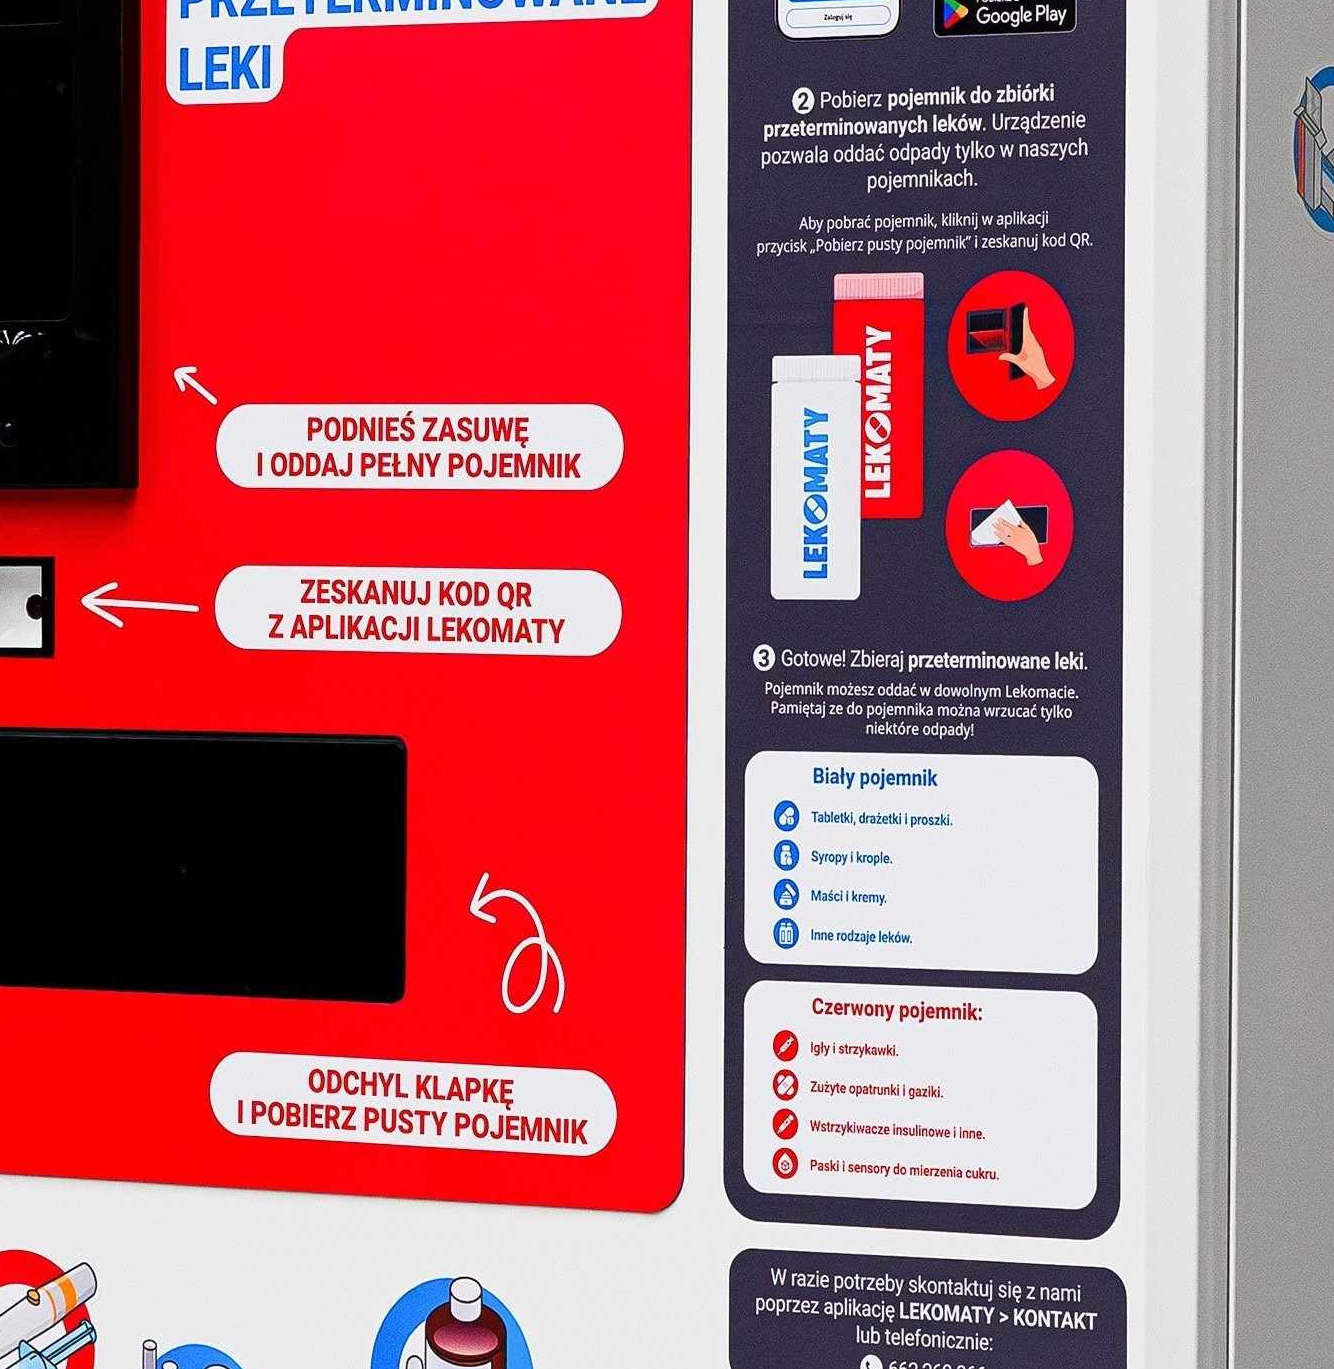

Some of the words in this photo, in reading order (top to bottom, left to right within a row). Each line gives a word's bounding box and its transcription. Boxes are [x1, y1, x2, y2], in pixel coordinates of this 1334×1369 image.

[976, 5, 1032, 27] Google
[1035, 4, 1067, 25] Play
[179, 44, 271, 91] LEKI
[820, 89, 882, 109] Pobierz
[887, 85, 966, 112] pojemnik
[970, 85, 992, 104] do
[996, 82, 1054, 103] zbiórki
[763, 114, 927, 142] przeterminowanych
[932, 113, 986, 132] leków.
[992, 110, 1086, 134] Urządzenie
[761, 145, 828, 169] pozwala
[833, 143, 884, 163] oddać
[889, 141, 951, 165] odpady
[954, 140, 995, 164] tylko
[999, 143, 1014, 158] w
[1019, 137, 1088, 161] naszych
[867, 167, 978, 193] pojemnikach.
[798, 215, 824, 234] Aby
[826, 214, 871, 233] pobrać
[874, 213, 937, 232] pojemnik,
[941, 212, 978, 230] kliknij
[981, 215, 993, 225] w
[996, 210, 1048, 229] aplikacji
[756, 238, 807, 257] przycisk
[809, 237, 864, 254] „Pobierz
[867, 238, 903, 255] pusty
[906, 234, 971, 254] pojemnik”
[981, 233, 1038, 251] zeskanuj
[1042, 232, 1066, 247] kod
[1069, 232, 1093, 249] QR.
[307, 411, 415, 442] PODNIEŚ
[422, 416, 529, 449] ZASUWĘ
[270, 451, 353, 477] ODDAJ
[360, 452, 441, 477] PEŁNY
[448, 452, 581, 478] POJEMNIK
[300, 578, 431, 606] ZESKANUJ
[439, 580, 490, 607] KOD
[497, 581, 531, 611] QR
[268, 613, 284, 639] Z
[289, 614, 419, 641] APLIKACJI
[427, 616, 565, 644] LEKOMATY
[781, 648, 845, 667] Gotowe!
[850, 648, 904, 672] Zbieraj
[908, 650, 1050, 672] przeterminowane
[1054, 651, 1088, 670] leki.
[765, 681, 824, 699] Pojemnik
[827, 682, 874, 696] możesz
[877, 682, 917, 697] oddać
[919, 686, 931, 697] w
[933, 683, 1001, 701] dowolnym
[1005, 684, 1079, 699] Lekomacie.
[771, 700, 826, 718] Pamiętaj
[829, 704, 843, 715] ze
[846, 701, 863, 715] do
[866, 702, 934, 719] pojemnika
[937, 703, 980, 717] można
[983, 703, 1037, 718] wrzucać
[1040, 704, 1073, 722] tylko
[865, 721, 919, 735] niektóre
[922, 721, 974, 740] odpady!
[813, 766, 855, 789] Biały
[860, 768, 938, 790] pojemnik
[810, 810, 856, 826] Tabletki,
[858, 811, 902, 825] drażetki
[910, 813, 953, 828] proszki.
[811, 850, 848, 866] Syropy
[856, 851, 893, 866] krople.
[810, 889, 843, 902] Maści
[851, 890, 887, 906] kremy.
[810, 928, 834, 941] Inne
[836, 929, 876, 945] rodzaje
[878, 930, 912, 944] leków.
[812, 997, 895, 1022] Czerwony
[899, 1000, 982, 1023] pojemnik:
[838, 1043, 899, 1058] strzykawki.
[308, 1068, 408, 1098] ODCHYL
[415, 1074, 514, 1111] KLAPKĘ
[810, 1080, 847, 1096] Zużyte
[848, 1083, 900, 1097] opatrunki
[908, 1085, 944, 1100] gaziki.
[251, 1100, 357, 1131] POBIERZ
[364, 1106, 448, 1136] PUSTY
[454, 1112, 588, 1145] POJEMNIK
[809, 1119, 890, 1136] Wstrzykiwacze
[892, 1123, 951, 1138] insulinowe
[810, 1158, 839, 1172] Paski
[847, 1163, 891, 1177] sensory
[893, 1162, 907, 1175] do
[909, 1164, 963, 1178] mierzenia
[965, 1167, 999, 1180] cukru.
[770, 1267, 787, 1286] W
[791, 1270, 830, 1288] razie
[834, 1273, 904, 1296] potrzeby
[908, 1275, 993, 1301] skontaktuj
[998, 1280, 1022, 1303] się
[1026, 1285, 1036, 1300] z
[1040, 1284, 1081, 1302] nami
[755, 1297, 819, 1316] poprzez
[823, 1297, 895, 1323] aplikację
[899, 1301, 995, 1324] LEKOMATY
[1013, 1308, 1098, 1330] KONTAKT
[856, 1325, 881, 1344] lub
[884, 1327, 993, 1351] telefonicznie:
